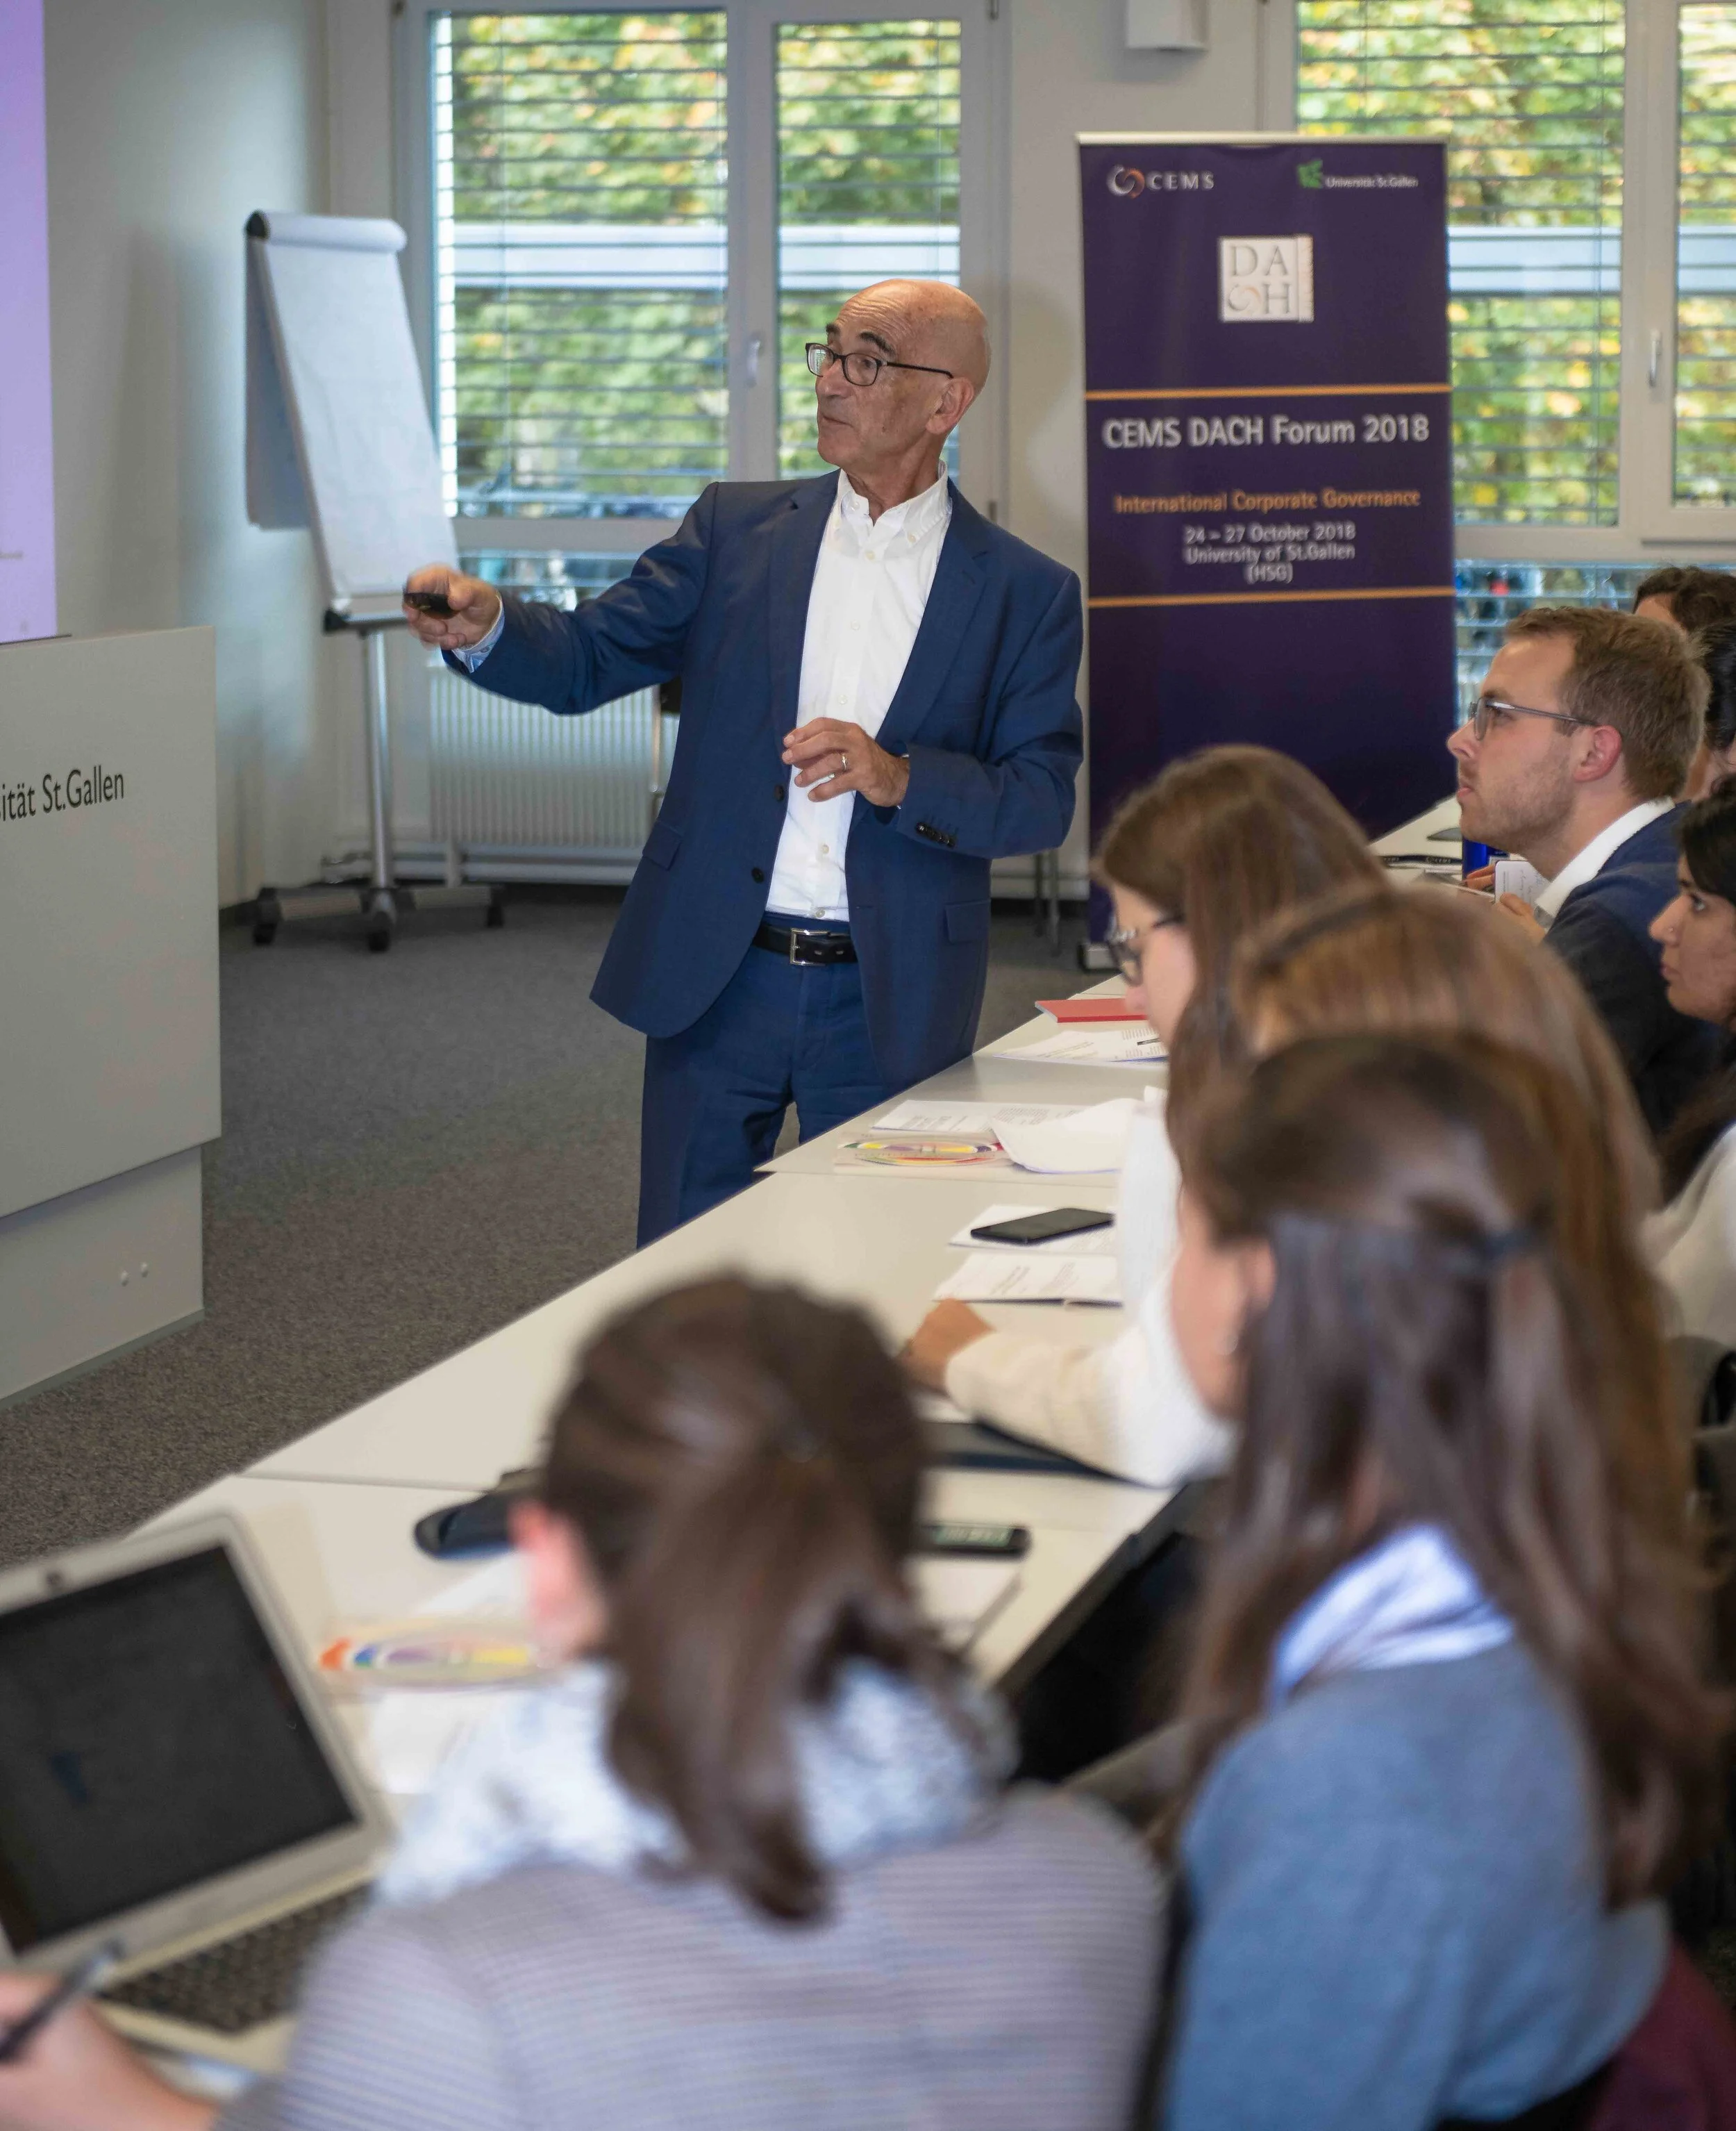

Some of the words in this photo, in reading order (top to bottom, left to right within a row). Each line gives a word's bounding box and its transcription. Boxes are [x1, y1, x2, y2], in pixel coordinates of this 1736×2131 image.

[1148, 172, 1215, 190] CEMS
[1230, 244, 1289, 277] DA
[1104, 418, 1181, 448] CEMS
[1190, 417, 1264, 446] DACH
[1272, 416, 1355, 445] Forum
[1363, 415, 1430, 442] 2018
[1115, 493, 1228, 513] International
[1231, 488, 1317, 513] Corporate
[1322, 488, 1421, 508] Governance
[1183, 525, 1205, 545] 24
[1223, 524, 1245, 543] 27
[1248, 522, 1310, 542] October
[1314, 521, 1355, 540] 2018
[1183, 544, 1261, 565] University
[1265, 544, 1282, 562] of
[1245, 563, 1293, 584] (HSG)
[0, 783, 36, 821] ität
[42, 765, 124, 813] St.Gallen
